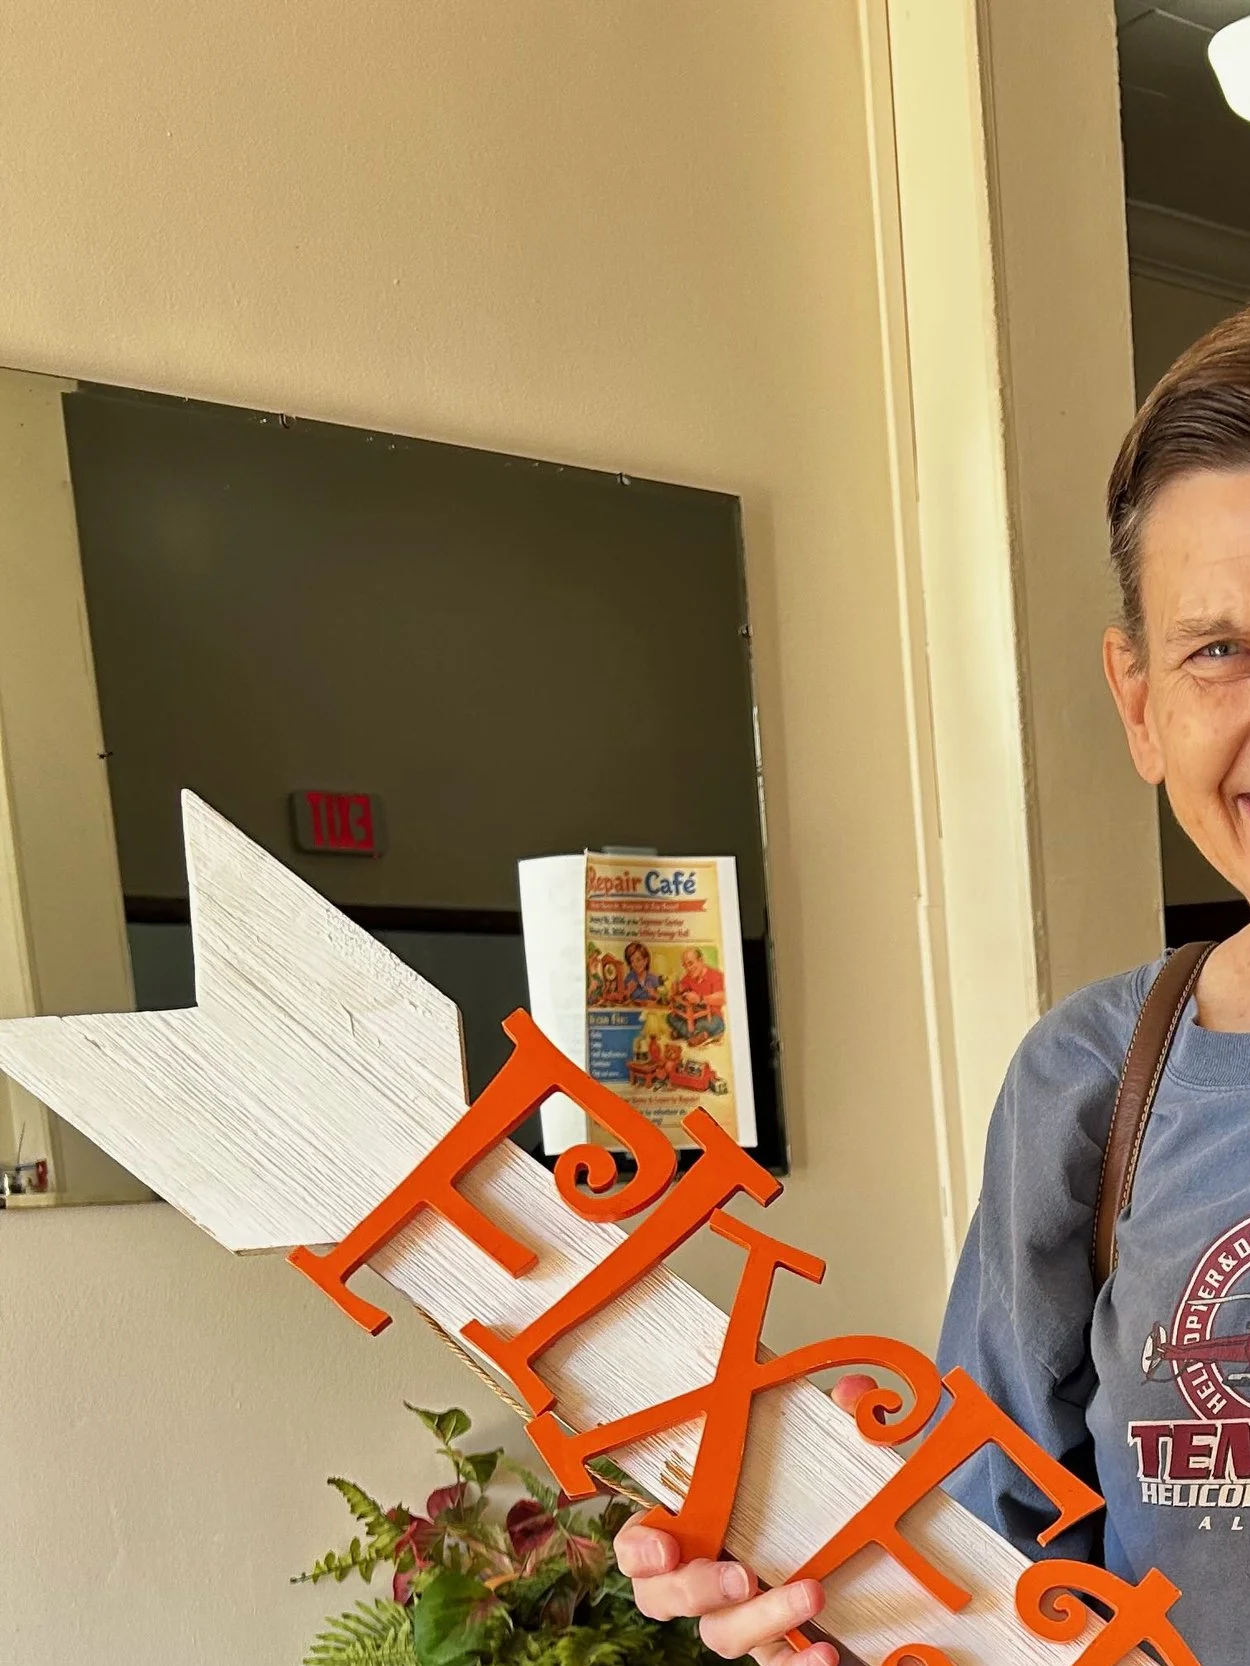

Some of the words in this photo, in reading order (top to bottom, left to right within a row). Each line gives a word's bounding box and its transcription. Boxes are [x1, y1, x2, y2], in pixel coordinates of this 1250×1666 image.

[587, 866, 642, 894] Repair
[644, 869, 696, 895] Café
[1183, 1268, 1227, 1415] HELIOPTER
[1217, 1251, 1239, 1272] &
